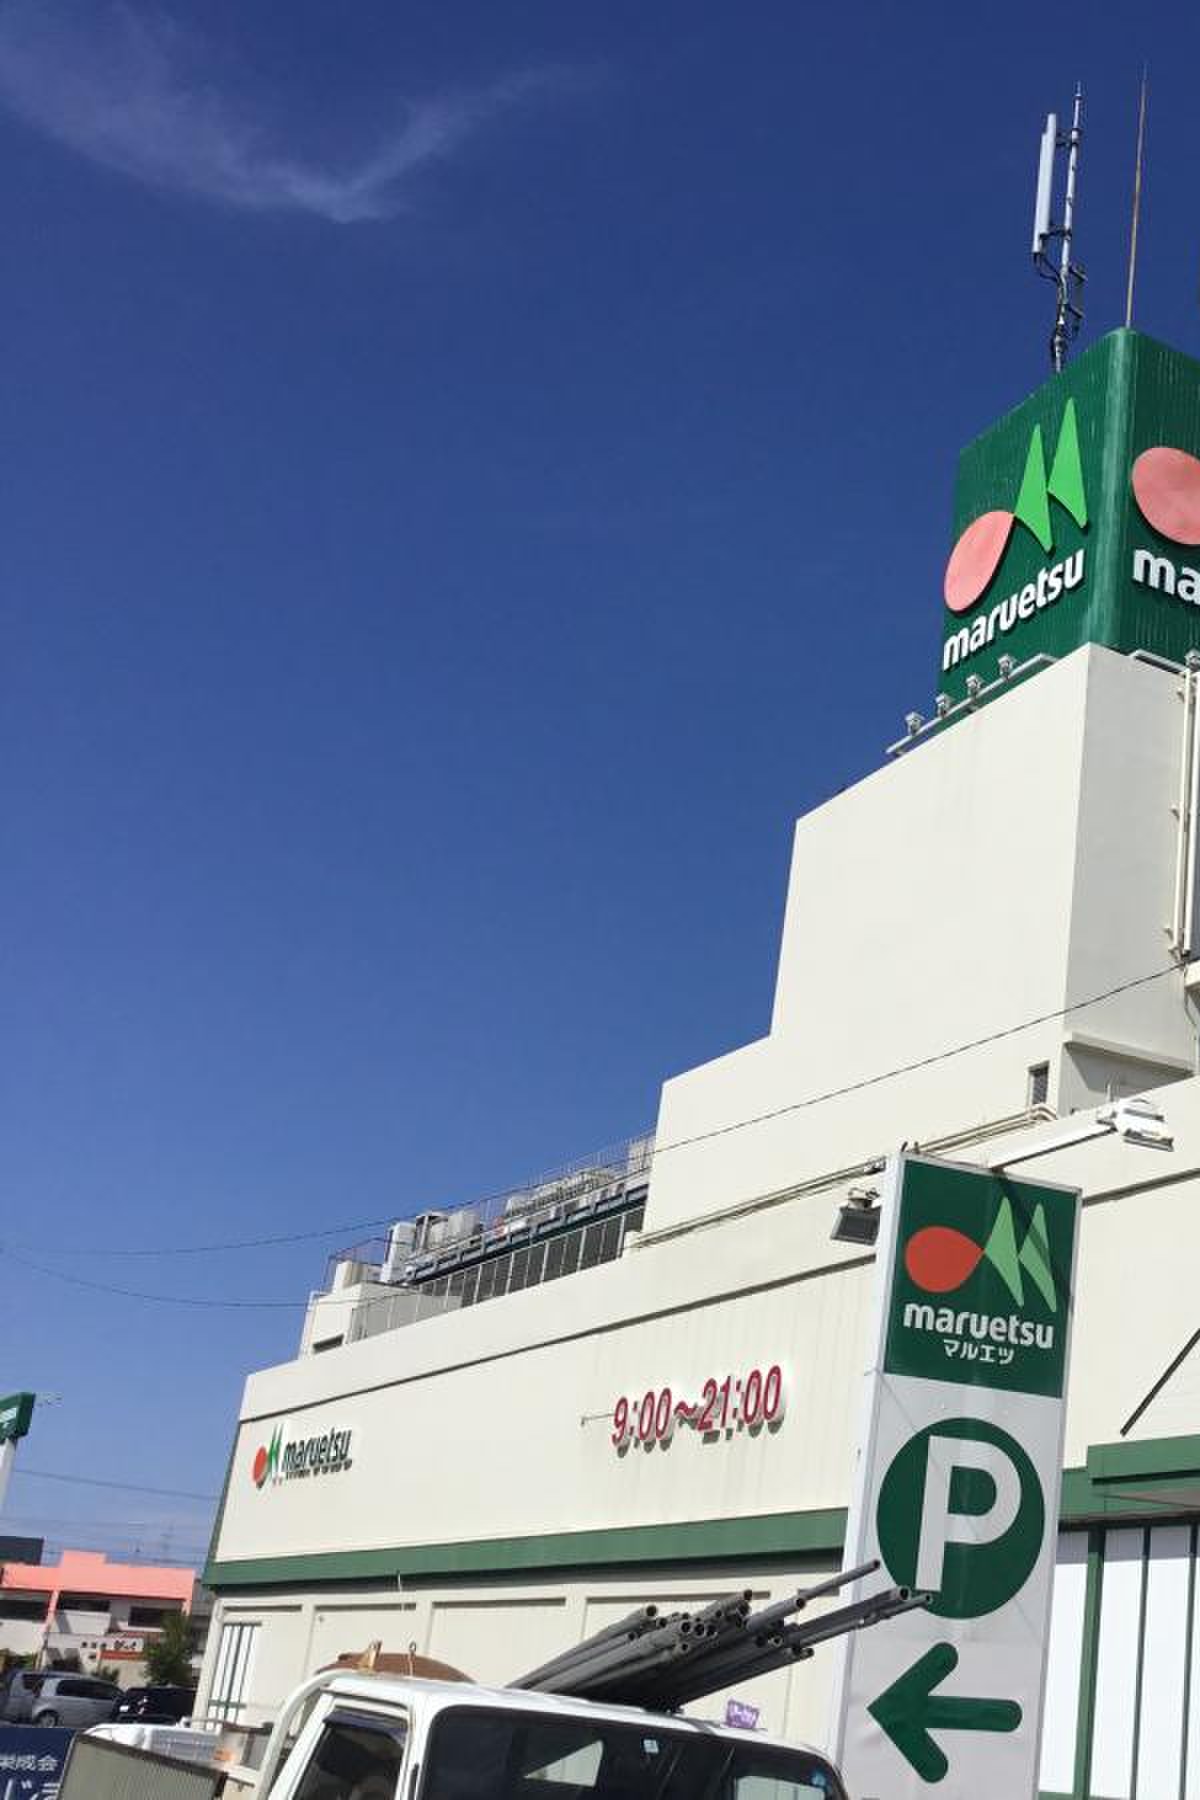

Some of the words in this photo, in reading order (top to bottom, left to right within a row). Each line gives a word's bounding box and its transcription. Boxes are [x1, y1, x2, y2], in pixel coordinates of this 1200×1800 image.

[942, 549, 1085, 671] maruetsu
[903, 1303, 1054, 1349] maruetsu
[943, 1338, 1014, 1364] マルエツ
[281, 1427, 353, 1473] maruetsu
[915, 1434, 1022, 1593] P
